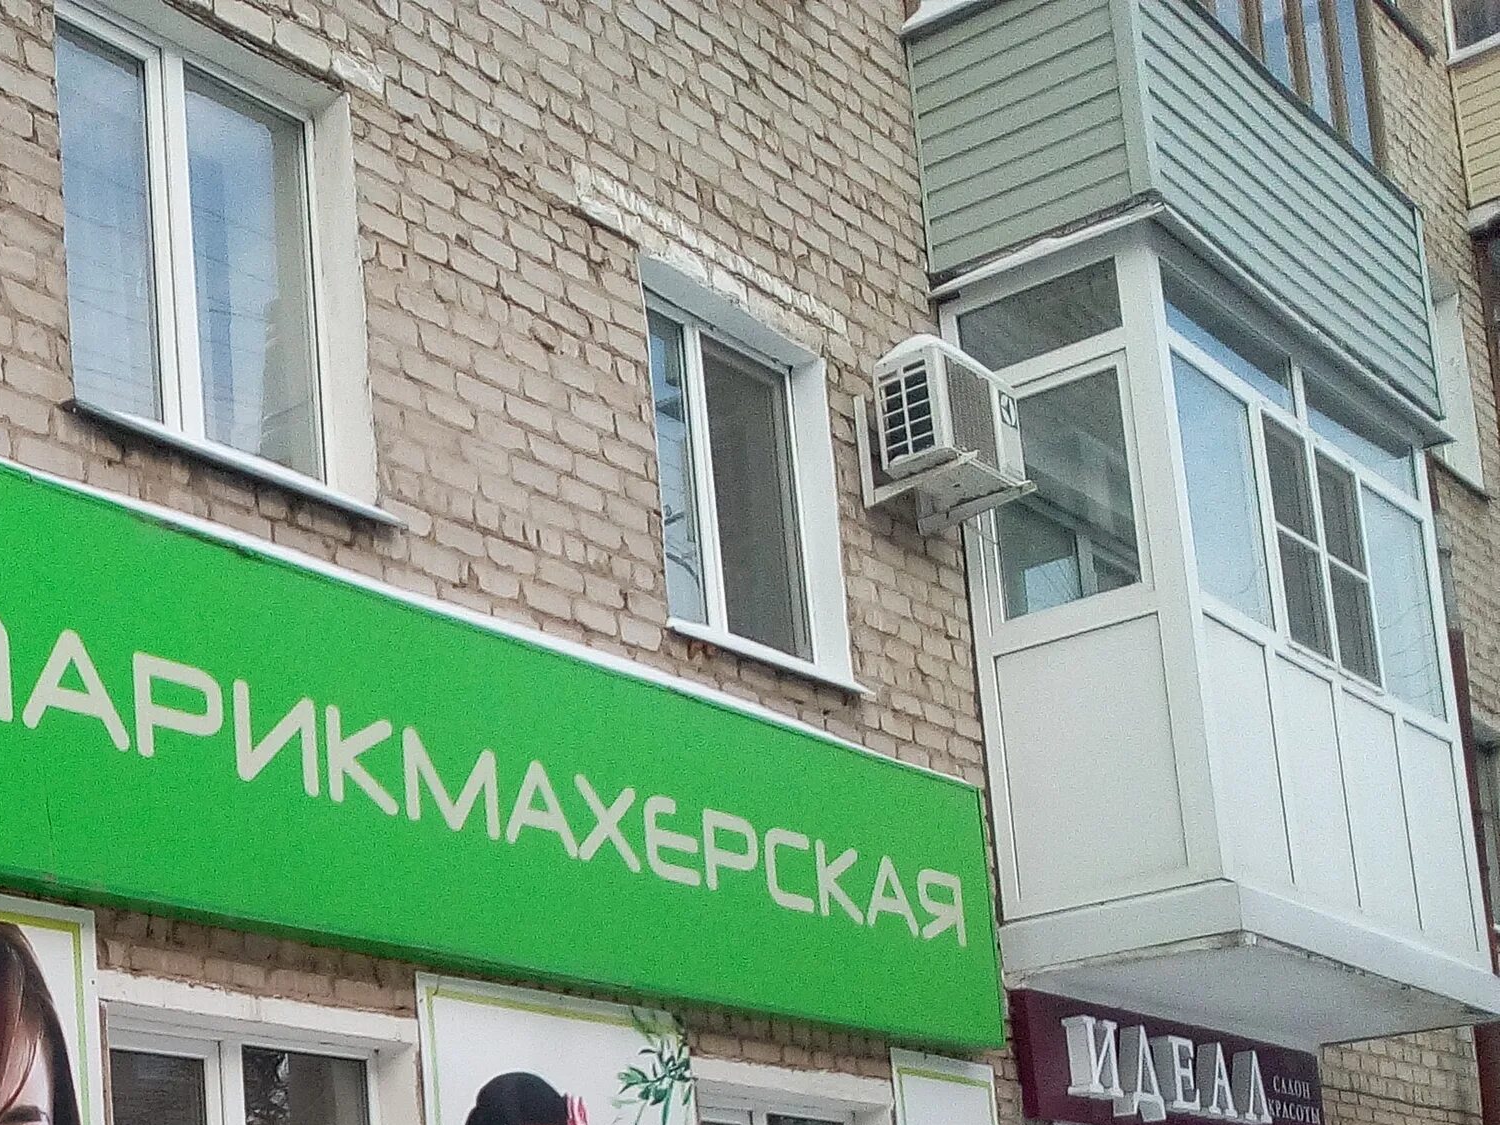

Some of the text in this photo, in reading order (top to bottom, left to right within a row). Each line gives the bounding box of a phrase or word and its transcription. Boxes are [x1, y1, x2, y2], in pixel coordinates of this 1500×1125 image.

[1060, 1013, 1273, 1123] ИДЕАЛ
[1273, 1074, 1310, 1099] САЛОН
[1268, 1098, 1321, 1125] КРАСОТЫ
